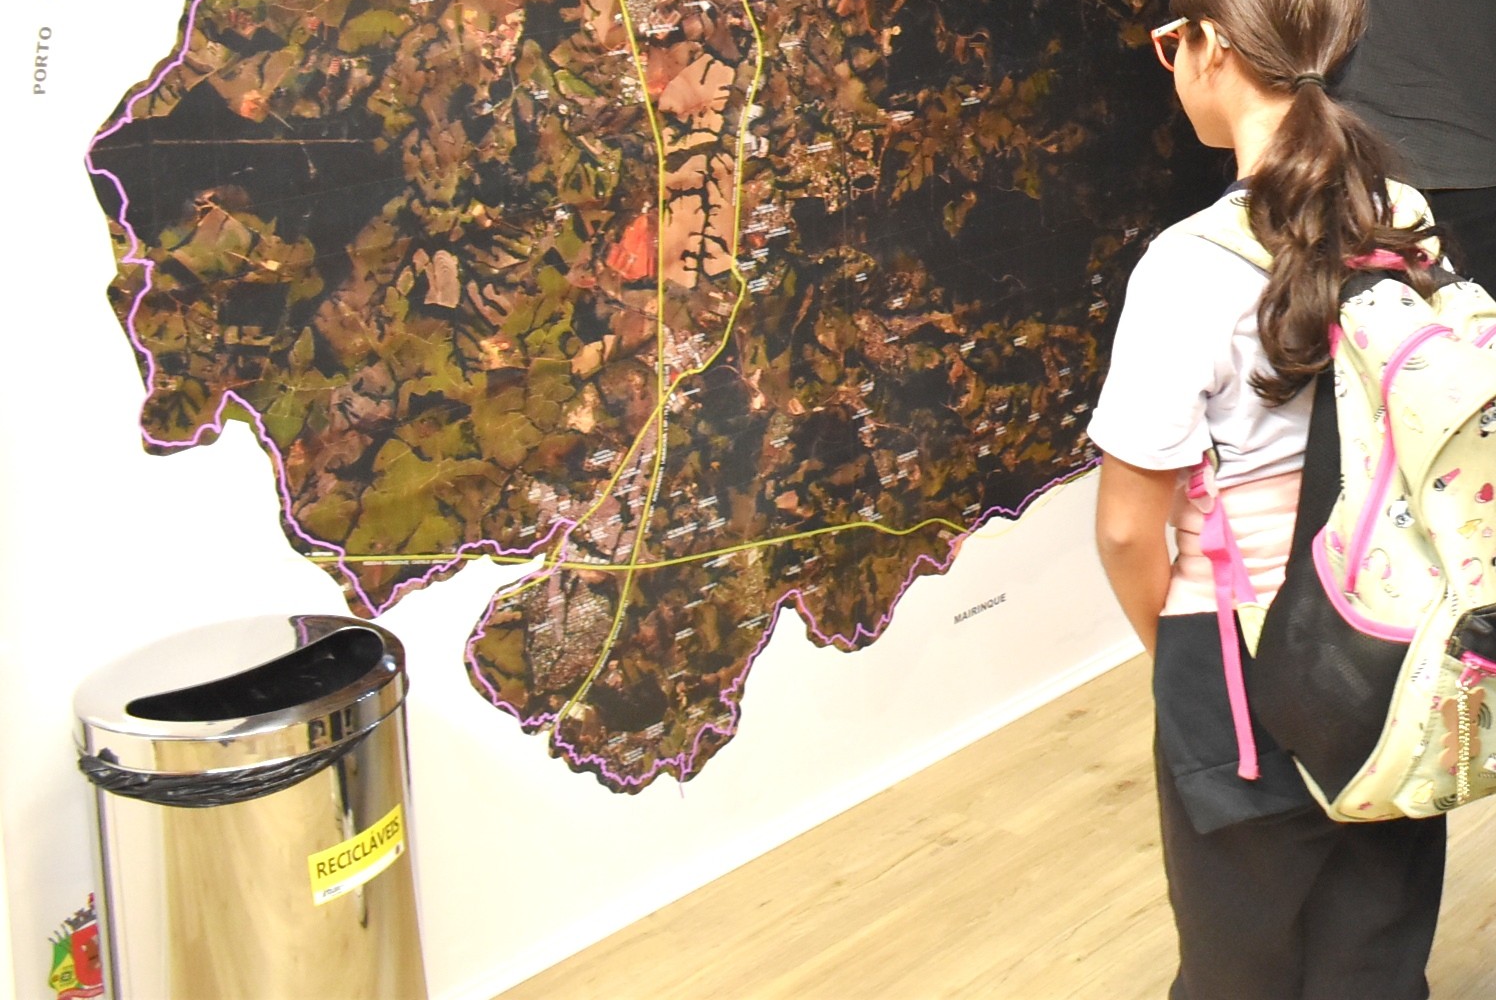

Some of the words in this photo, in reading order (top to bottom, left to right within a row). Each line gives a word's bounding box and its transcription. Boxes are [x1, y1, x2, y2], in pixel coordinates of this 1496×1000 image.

[33, 26, 53, 95] PORTO
[953, 592, 1007, 625] MAIRINQUE
[316, 816, 400, 879] RECICLÁVEIS
